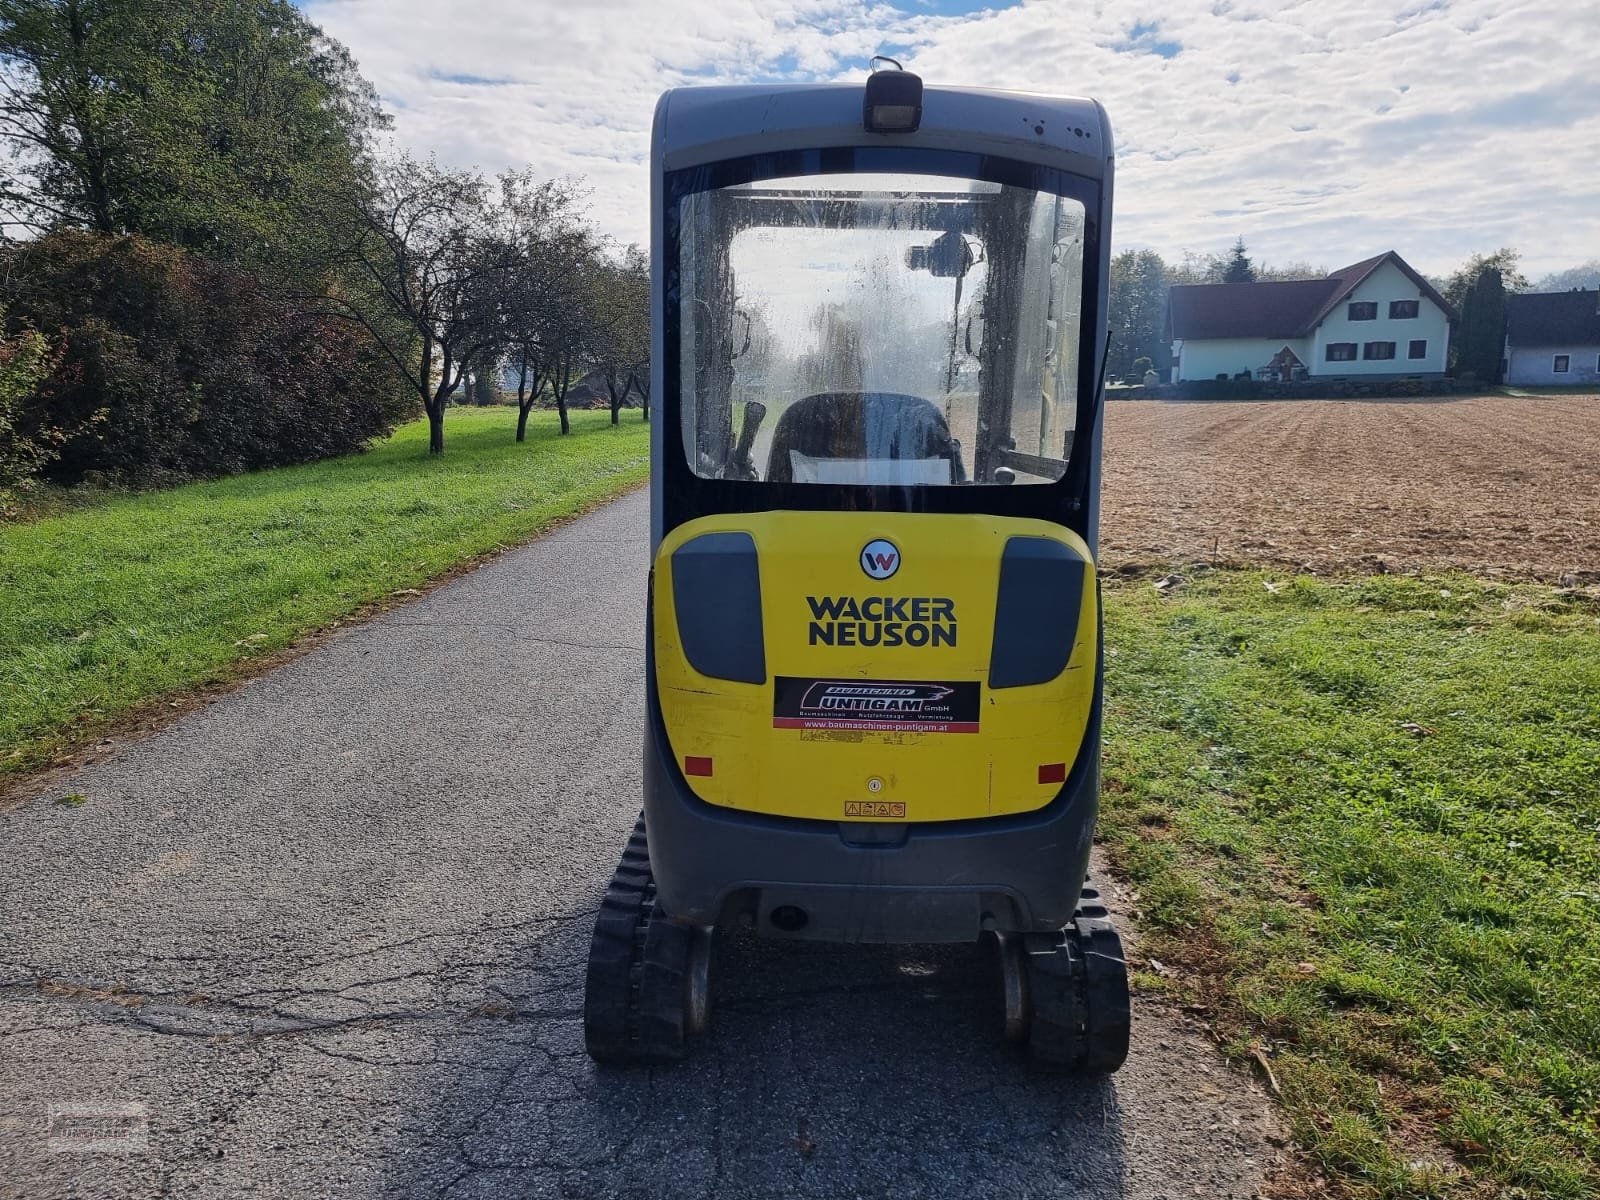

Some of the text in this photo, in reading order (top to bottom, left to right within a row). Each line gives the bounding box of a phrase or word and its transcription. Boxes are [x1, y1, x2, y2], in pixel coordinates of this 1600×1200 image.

[865, 553, 896, 571] W
[806, 597, 957, 622] WACKER
[808, 622, 957, 647] NEUSON
[804, 721, 948, 732] www.baumaschinen-puntigam.at
